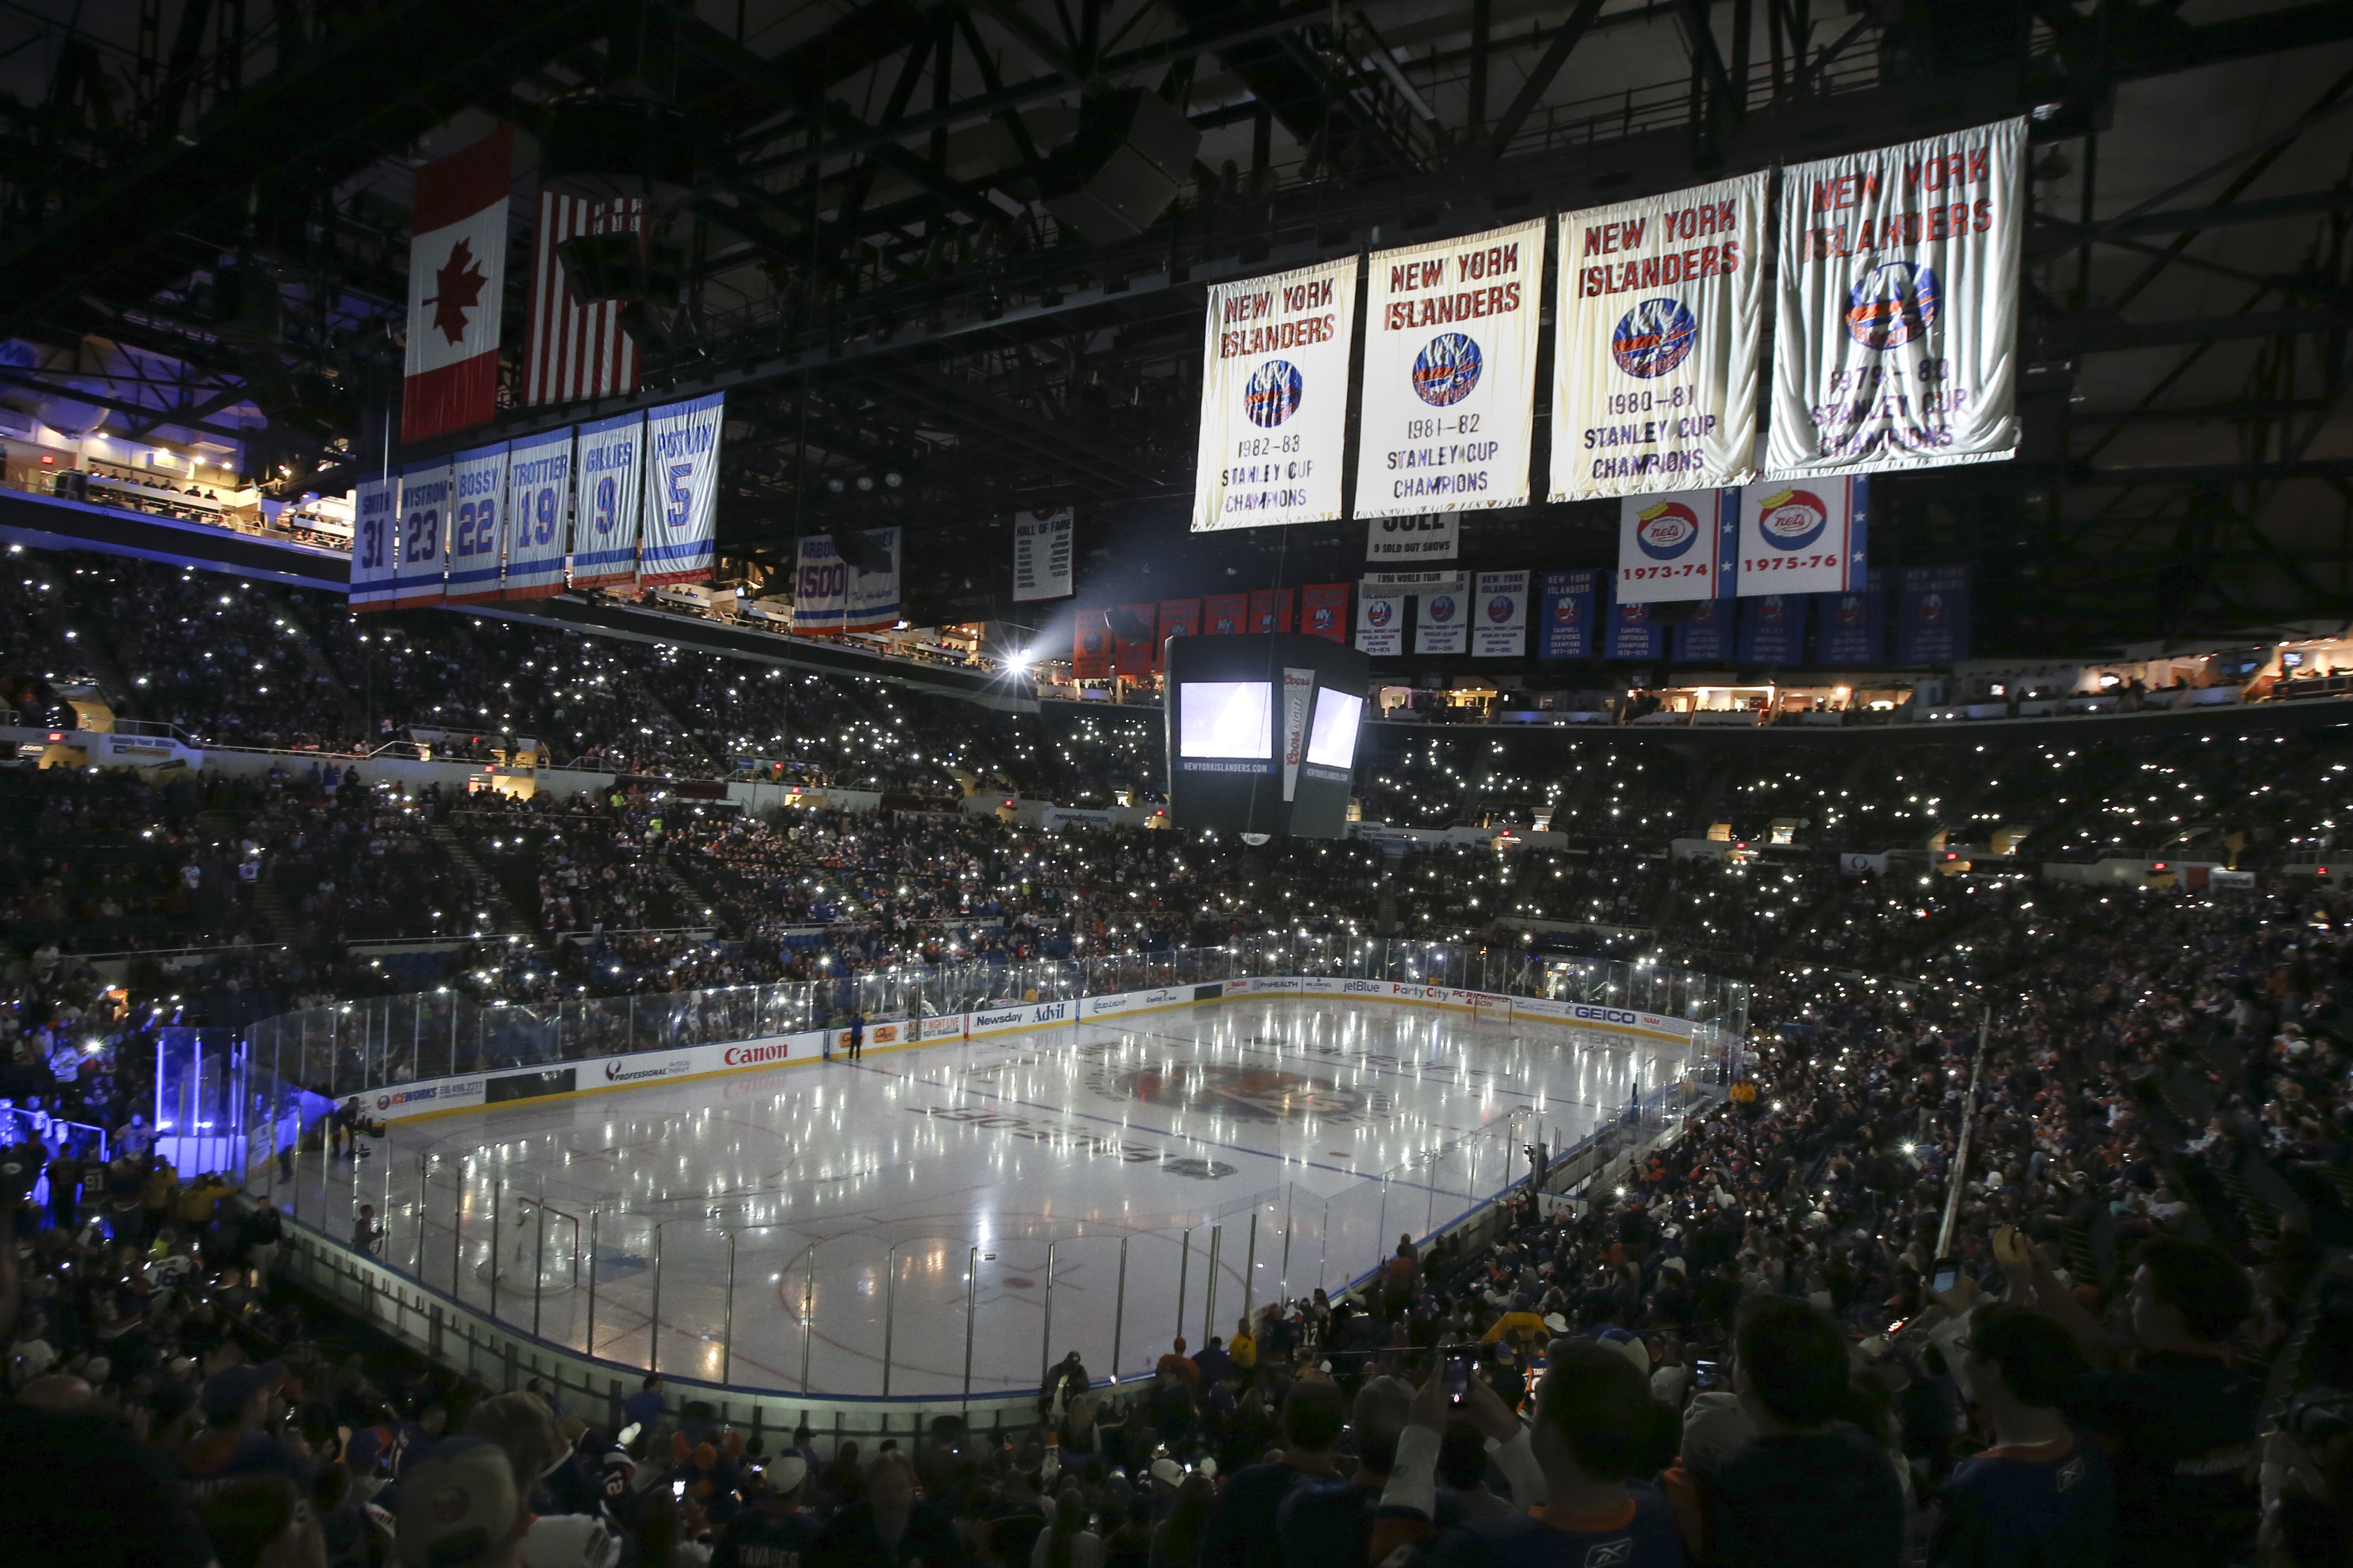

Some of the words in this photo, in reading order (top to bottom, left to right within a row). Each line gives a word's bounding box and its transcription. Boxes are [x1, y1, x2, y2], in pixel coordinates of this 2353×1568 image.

[1813, 172, 1880, 213] NEW
[1904, 148, 1988, 196] YORK
[1584, 217, 1647, 258] NEW
[1664, 198, 1736, 242] YORK
[1804, 198, 1993, 263] ISLANDERS
[1390, 258, 1444, 293] NEW
[1458, 242, 1520, 282] YORK
[1579, 240, 1740, 298] ISLANDERS
[1225, 291, 1270, 324] NEW
[1283, 277, 1334, 313] YORK
[1384, 281, 1520, 331] ISLANDERS
[1221, 313, 1336, 359] ISLANDERS
[1921, 387, 1968, 414] CUP
[656, 424, 712, 461] POTVIN
[1584, 418, 1668, 449] STANLEY
[1678, 414, 1716, 439] CUP
[586, 442, 633, 472] GILLIES
[1387, 444, 1458, 470] STANLEY
[1466, 441, 1499, 462] CUP
[1592, 448, 1705, 480] CHAMPIONS
[459, 468, 499, 498] BOSSY
[513, 453, 568, 487] TROTTIER
[1221, 464, 1280, 487] STANLEY
[1288, 460, 1315, 480] CUP
[403, 479, 447, 509] NYSTROM
[667, 462, 693, 527] 5
[1393, 471, 1488, 499] CHAMPIONS
[363, 491, 390, 516] SMITH
[596, 476, 617, 535] 9
[1225, 488, 1307, 513] CHAMPIONS
[458, 498, 495, 557] 22
[519, 486, 556, 548] 19
[1017, 525, 1035, 536] HALL
[1039, 523, 1048, 534] OF
[1051, 518, 1071, 532] FAME
[362, 518, 384, 569] 31
[407, 509, 438, 563] 23
[1374, 544, 1380, 553] 9
[1383, 543, 1402, 553] SOLD
[1404, 542, 1421, 552] OUT
[1422, 541, 1450, 551] SHOWS
[1623, 564, 1707, 580] 1973-74
[1744, 554, 1838, 572] 1975-76
[796, 562, 845, 598] 1500
[1397, 574, 1420, 583] WORLD
[1423, 573, 1441, 582] TOUR
[1481, 584, 1523, 593] ISLANDERS
[1482, 575, 1500, 583] NEW
[1504, 574, 1524, 583] YORK
[1547, 575, 1565, 584] NEW
[1570, 573, 1590, 583] YORK
[1547, 584, 1590, 595] ISLANDERS
[1283, 674, 1310, 686] Coors
[1291, 697, 1303, 730] LIGHT
[1286, 731, 1300, 766] Coors
[1184, 762, 1268, 773] NEWYORKISLANDERS.COM
[1054, 813, 1108, 823] newsday.com
[1343, 980, 1380, 993] jetBlue
[1393, 984, 1425, 998] Party
[1426, 987, 1449, 1001] City
[977, 1012, 1023, 1026] Newsday
[1032, 1003, 1065, 1022] Advil
[1575, 1006, 1636, 1024] GEICO
[724, 1043, 788, 1066] Canon
[614, 1067, 667, 1082] PROFESSIONAL
[85, 1175, 104, 1191] 91
[1302, 1327, 1318, 1346] 17
